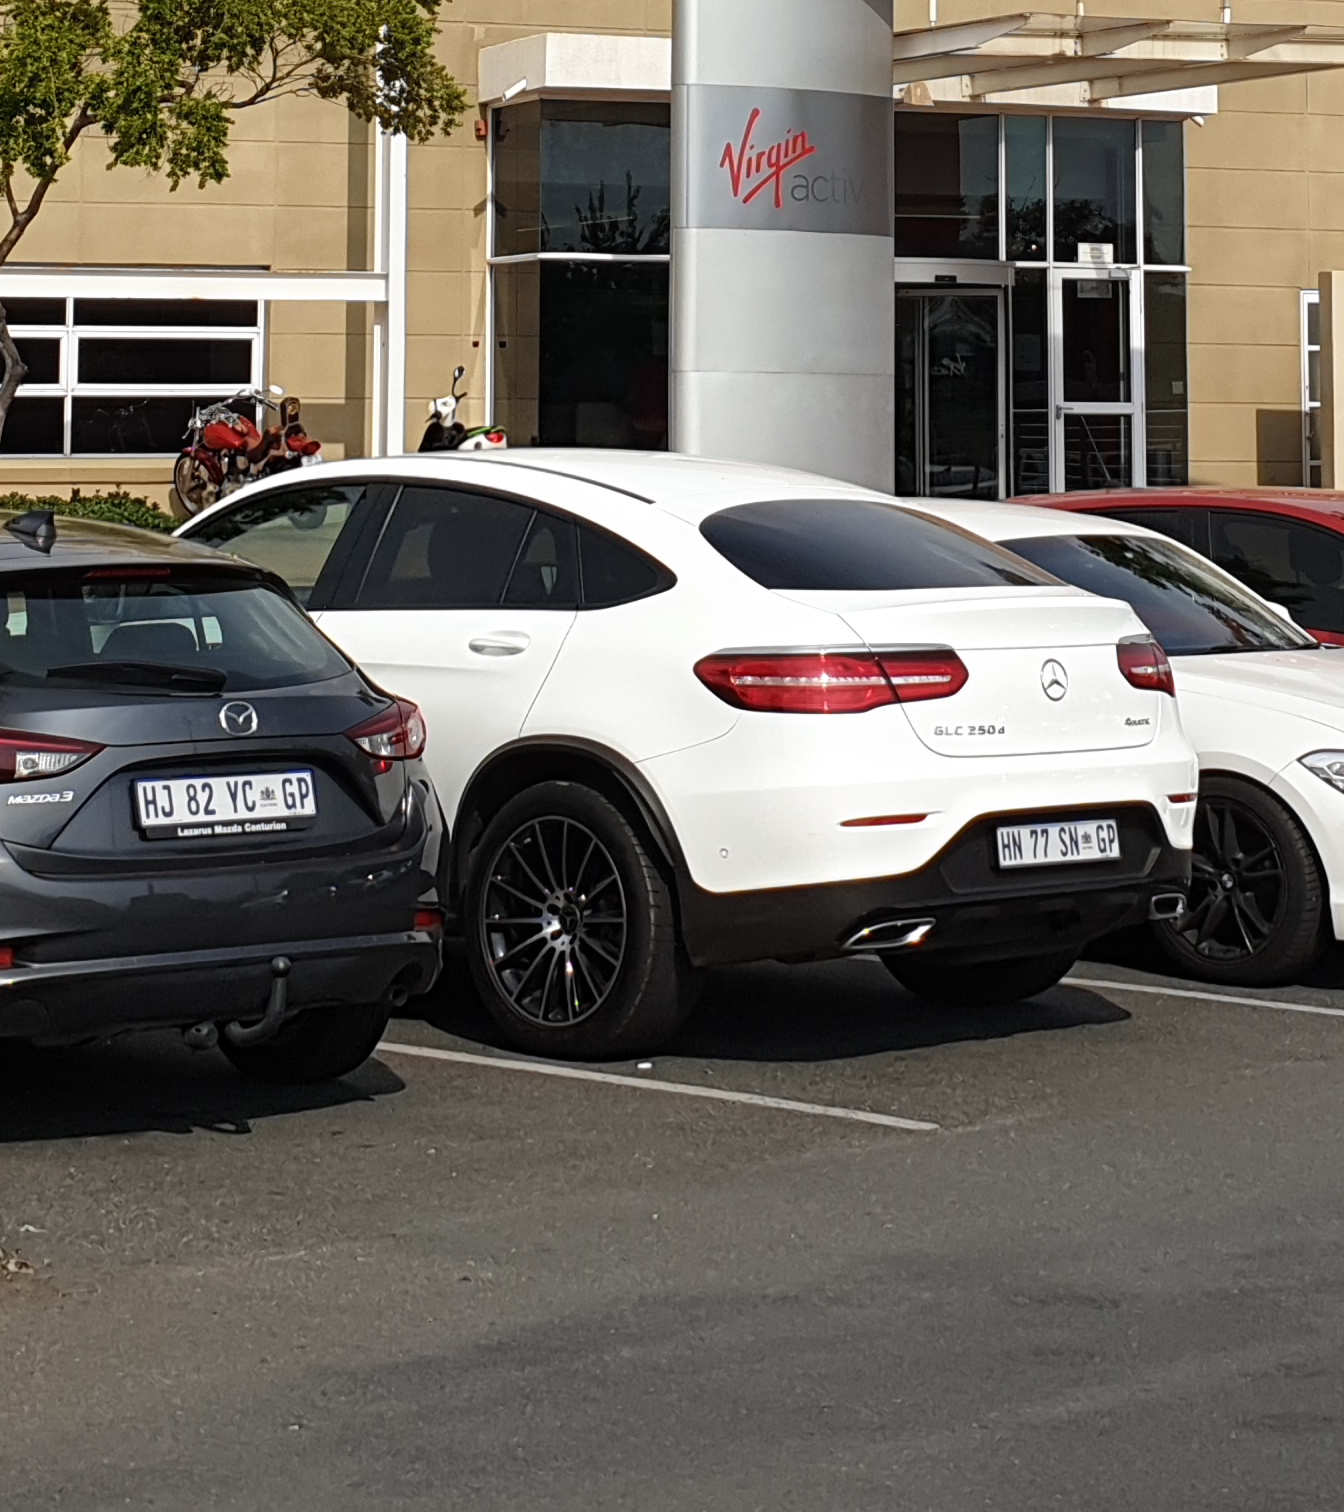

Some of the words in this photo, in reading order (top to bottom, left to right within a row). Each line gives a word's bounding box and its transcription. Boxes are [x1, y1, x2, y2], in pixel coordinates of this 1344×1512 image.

[719, 107, 817, 209] Virgin
[789, 168, 870, 205] activ
[933, 725, 964, 736] GLC
[142, 784, 175, 820] HJ
[185, 781, 217, 816] 82
[225, 779, 257, 814] YC
[281, 776, 311, 812] GP
[177, 825, 213, 837] Lazarus
[214, 824, 243, 835] Mazda
[244, 821, 287, 833] Centurion
[1000, 829, 1023, 862] HN
[1029, 828, 1049, 859] 77
[1058, 826, 1081, 857] SN
[1095, 823, 1116, 854] GP
